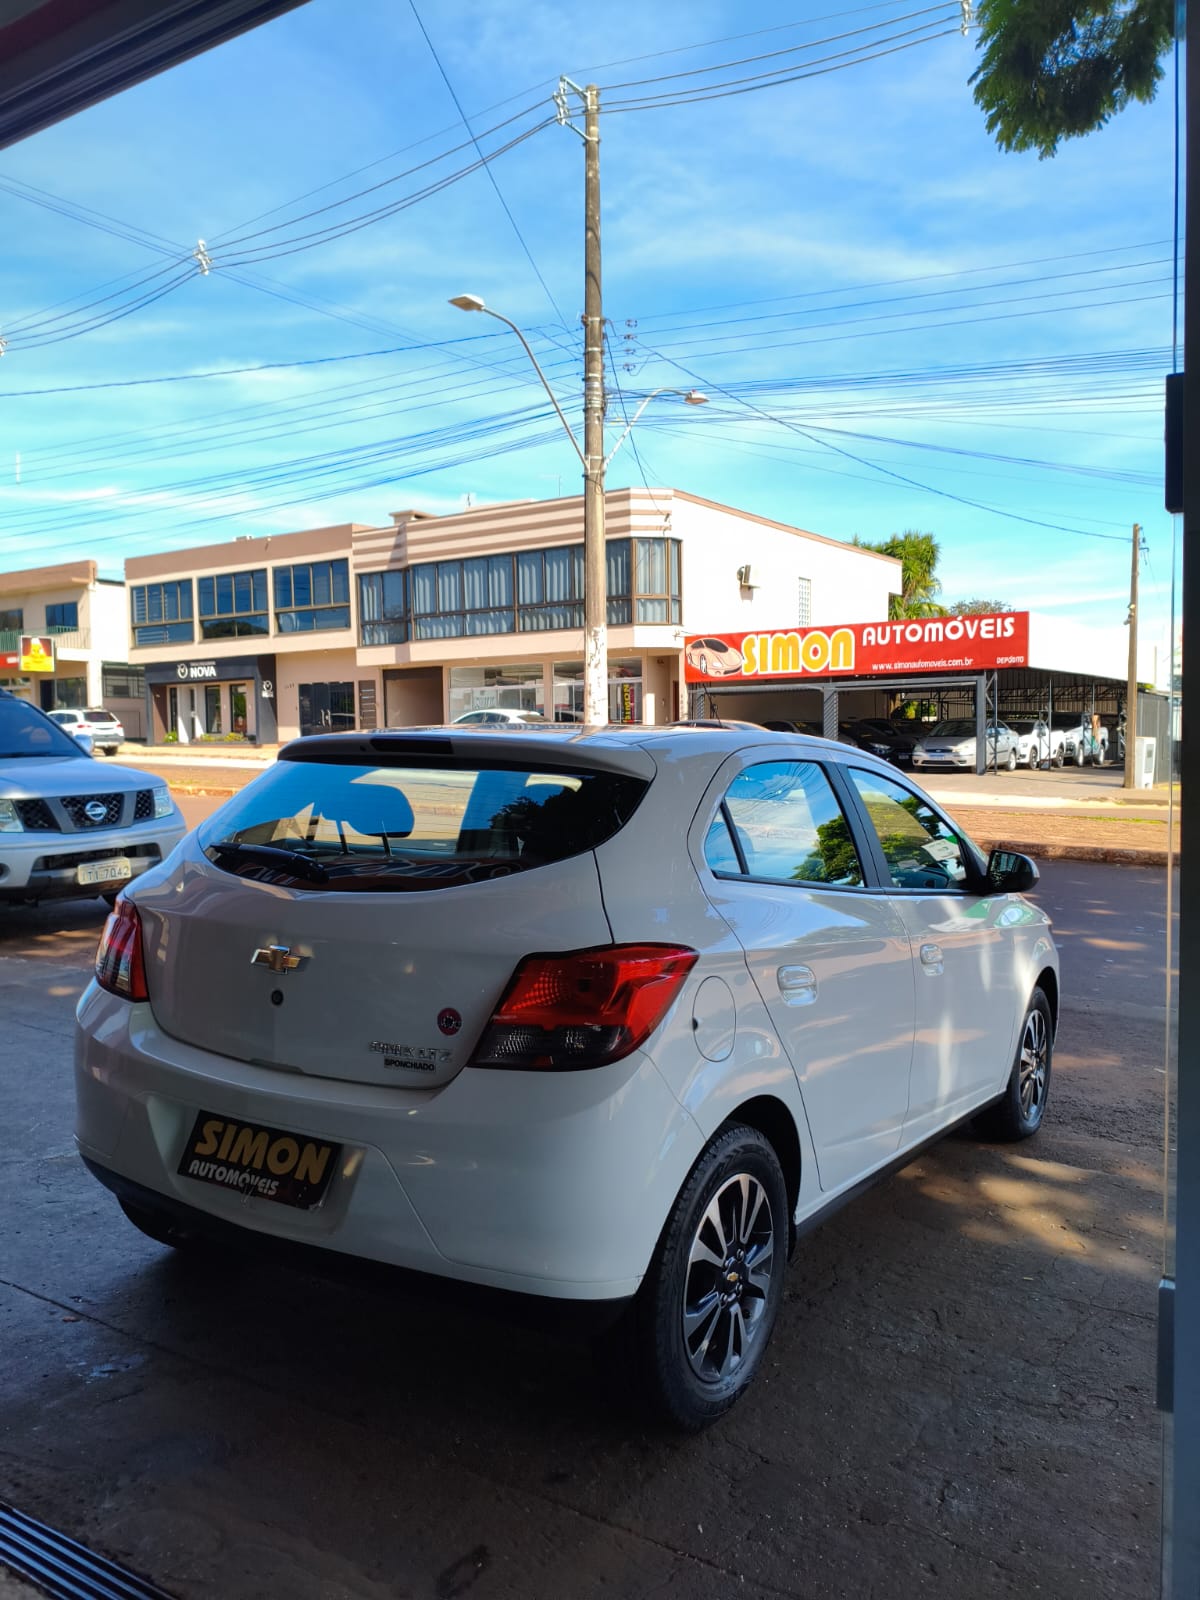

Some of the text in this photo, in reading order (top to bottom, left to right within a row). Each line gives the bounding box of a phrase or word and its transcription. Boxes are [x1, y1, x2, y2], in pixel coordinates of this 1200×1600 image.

[742, 616, 1014, 675] SIMON AUTOMÓVEIS
[190, 666, 216, 678] NOVA
[194, 1120, 332, 1184] SIMON
[188, 1159, 280, 1196] AUTOMÓVEIS
